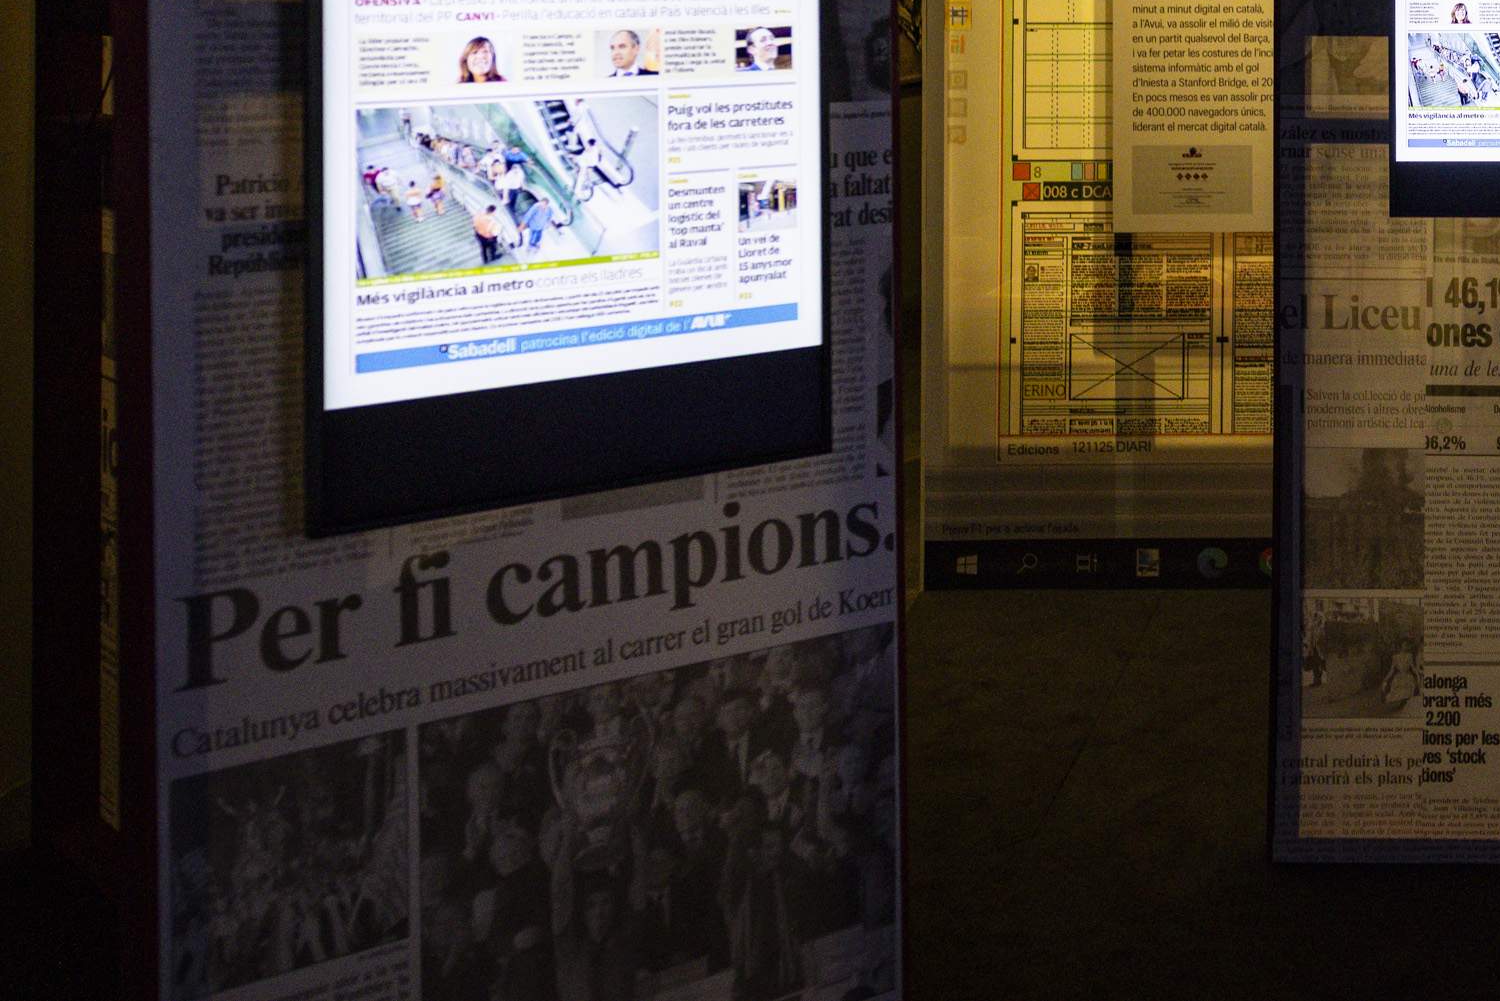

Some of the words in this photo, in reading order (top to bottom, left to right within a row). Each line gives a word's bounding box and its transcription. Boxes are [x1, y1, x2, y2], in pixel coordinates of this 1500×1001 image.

[456, 12, 496, 22] CANVI
[668, 104, 693, 118] Puig
[733, 99, 793, 116] prostitutes
[1146, 107, 1186, 117] 400.000
[1188, 108, 1238, 119] navegadors
[668, 119, 692, 131] fora
[729, 115, 784, 128] carreteres
[356, 289, 390, 307] Més
[392, 282, 467, 306] vigilància
[487, 278, 534, 293] metro
[1320, 293, 1421, 330] Liceu
[1304, 352, 1353, 365] manera
[1357, 350, 1427, 366] immediata
[1429, 364, 1458, 377] una
[1464, 360, 1481, 377] de
[1007, 443, 1059, 457] Edicions
[174, 586, 362, 692] Per
[395, 550, 456, 649] fi
[487, 500, 895, 627] campions.
[170, 710, 321, 759] Catalunya
[329, 685, 421, 726] celebra
[429, 650, 587, 704] massivament
[620, 629, 686, 661] carrer
[716, 613, 764, 649] gran
[770, 602, 802, 636] gol
[1465, 693, 1492, 708] més
[1426, 712, 1461, 726] 2.200
[1456, 732, 1479, 747] per
[1482, 730, 1500, 745] les
[1332, 754, 1380, 768] reduirà
[1378, 772, 1413, 787] plans
